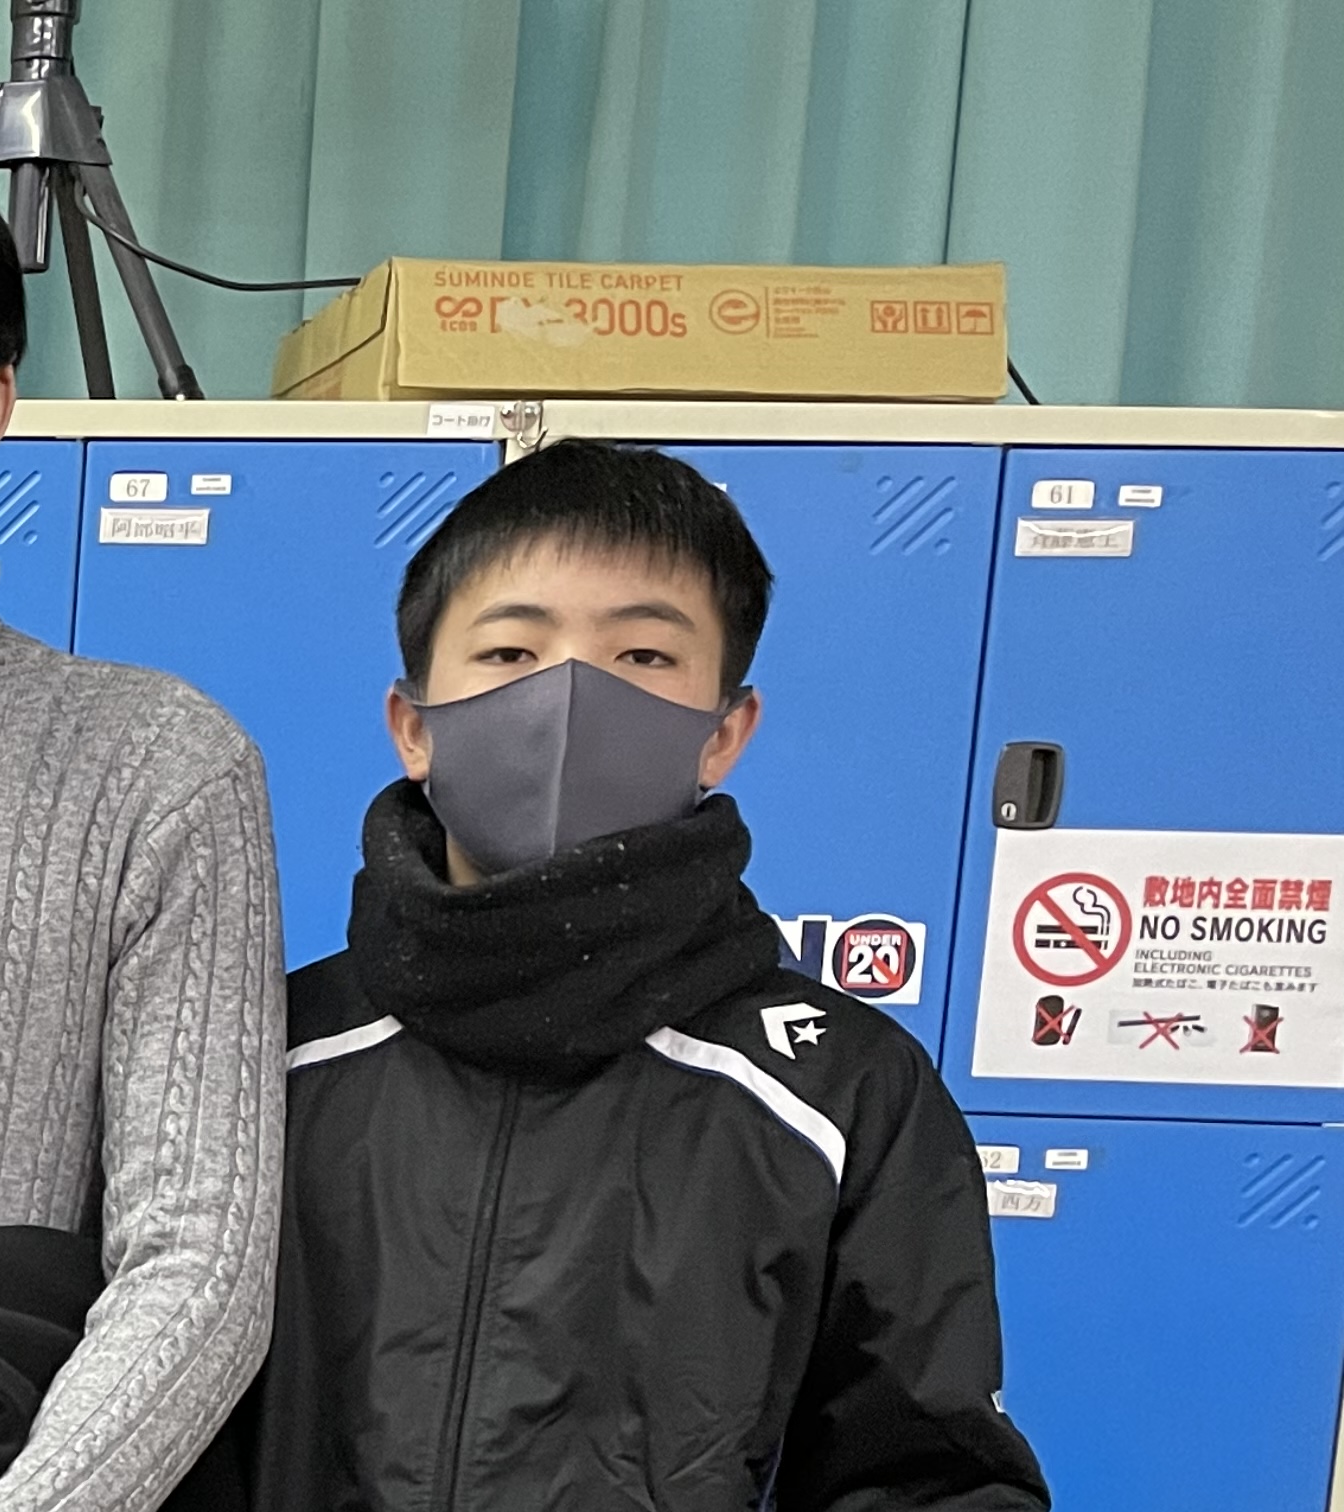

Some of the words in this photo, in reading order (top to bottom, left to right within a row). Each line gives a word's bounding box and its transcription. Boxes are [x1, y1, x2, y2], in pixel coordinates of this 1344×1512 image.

[546, 272, 594, 290] TILE
[600, 273, 685, 292] CARPET
[126, 478, 151, 497] 67
[1049, 484, 1073, 505] 61
[1139, 915, 1181, 941] NO
[1190, 916, 1328, 945] SMOKING
[849, 933, 902, 947] UNDER
[836, 945, 900, 985] 20
[1135, 949, 1213, 962] INCLUDING
[1133, 962, 1222, 976] ELECTRONIC
[1225, 964, 1313, 978] CIGARETTES
